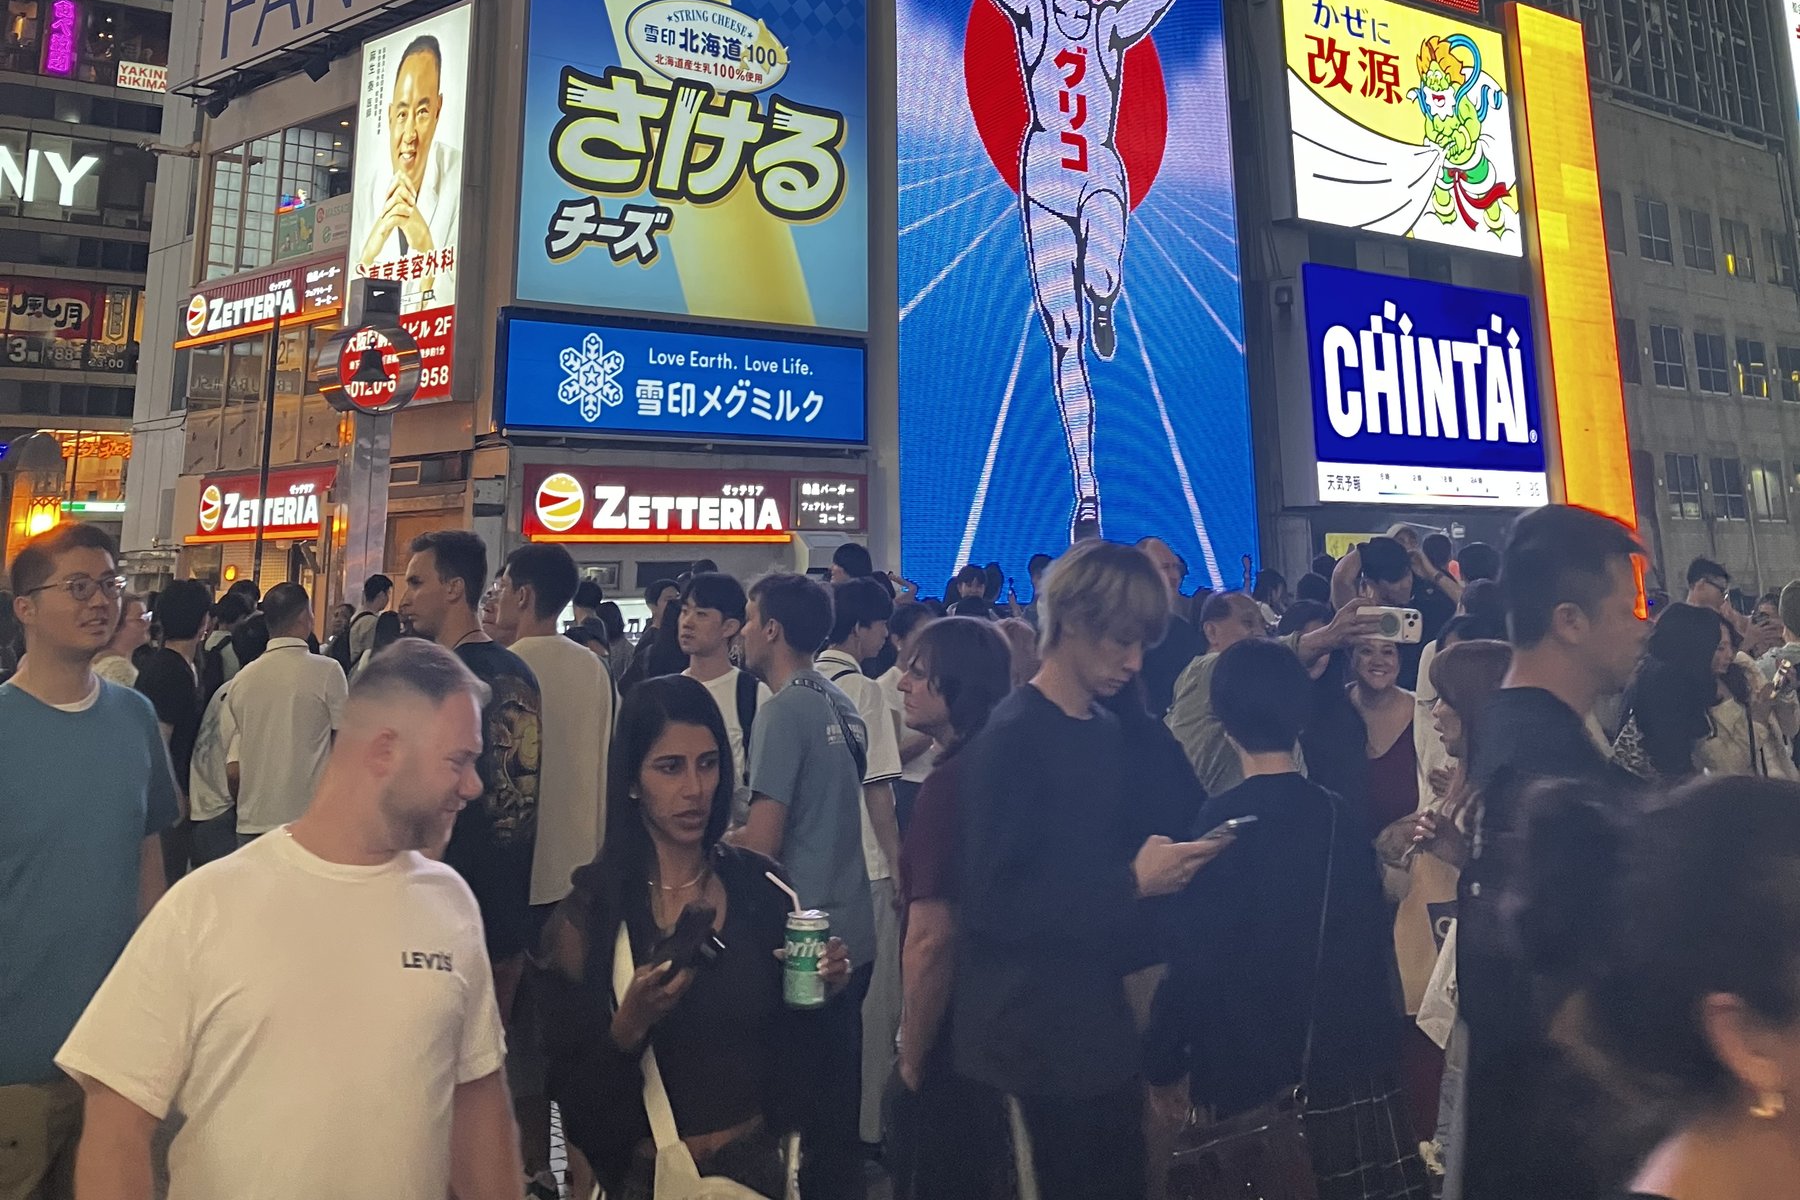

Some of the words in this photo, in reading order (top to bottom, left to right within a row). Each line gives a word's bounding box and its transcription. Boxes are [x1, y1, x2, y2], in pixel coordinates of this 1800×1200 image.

[673, 8, 709, 23] STRING
[711, 12, 749, 38] CHEESE
[655, 53, 763, 85] 北海道産生乳100%使用
[1304, 33, 1403, 105] 改源
[1053, 46, 1088, 173] グリコ
[552, 68, 843, 218] さける
[549, 202, 669, 259] チーズ
[368, 246, 455, 282] 東京美容外科
[206, 288, 296, 332] ZETTERIA
[434, 315, 453, 338] 2F
[420, 365, 449, 388] 958
[648, 347, 686, 367] Love
[689, 350, 738, 370] Earth.
[744, 355, 779, 373] Love
[782, 358, 814, 376] Life.
[1322, 300, 1530, 444] CHINTAI
[635, 378, 824, 424] 雪印メグミルク
[222, 492, 319, 529] ZETTERIA
[592, 484, 784, 531] ZETTERIA
[818, 513, 855, 525] コーヒー
